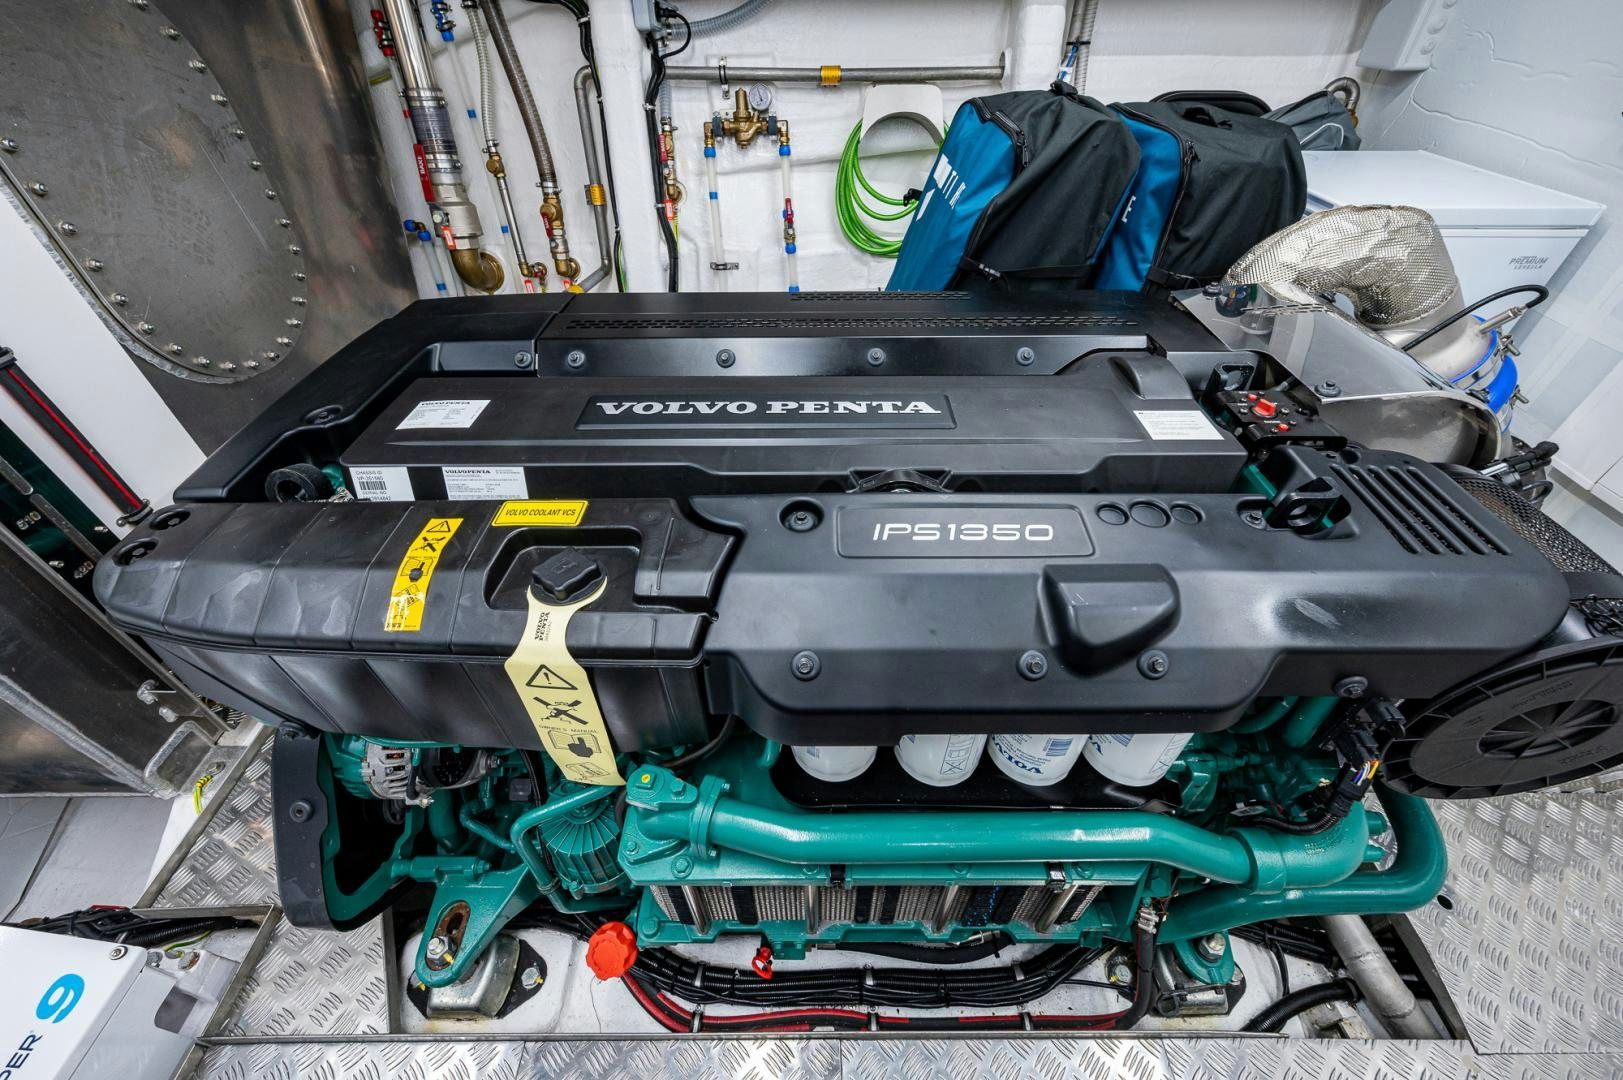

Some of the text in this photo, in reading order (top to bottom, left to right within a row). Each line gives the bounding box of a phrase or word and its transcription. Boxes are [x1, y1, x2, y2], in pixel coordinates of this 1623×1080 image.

[1509, 257, 1549, 265] PREMIUM
[597, 401, 942, 415] VOLVO PENTA
[505, 508, 577, 517] VOLVO COOLANT VCS
[872, 523, 1054, 541] IPS1350
[534, 611, 545, 640] VOLVO
[539, 611, 551, 641] PENTA
[36, 973, 86, 1024] 9
